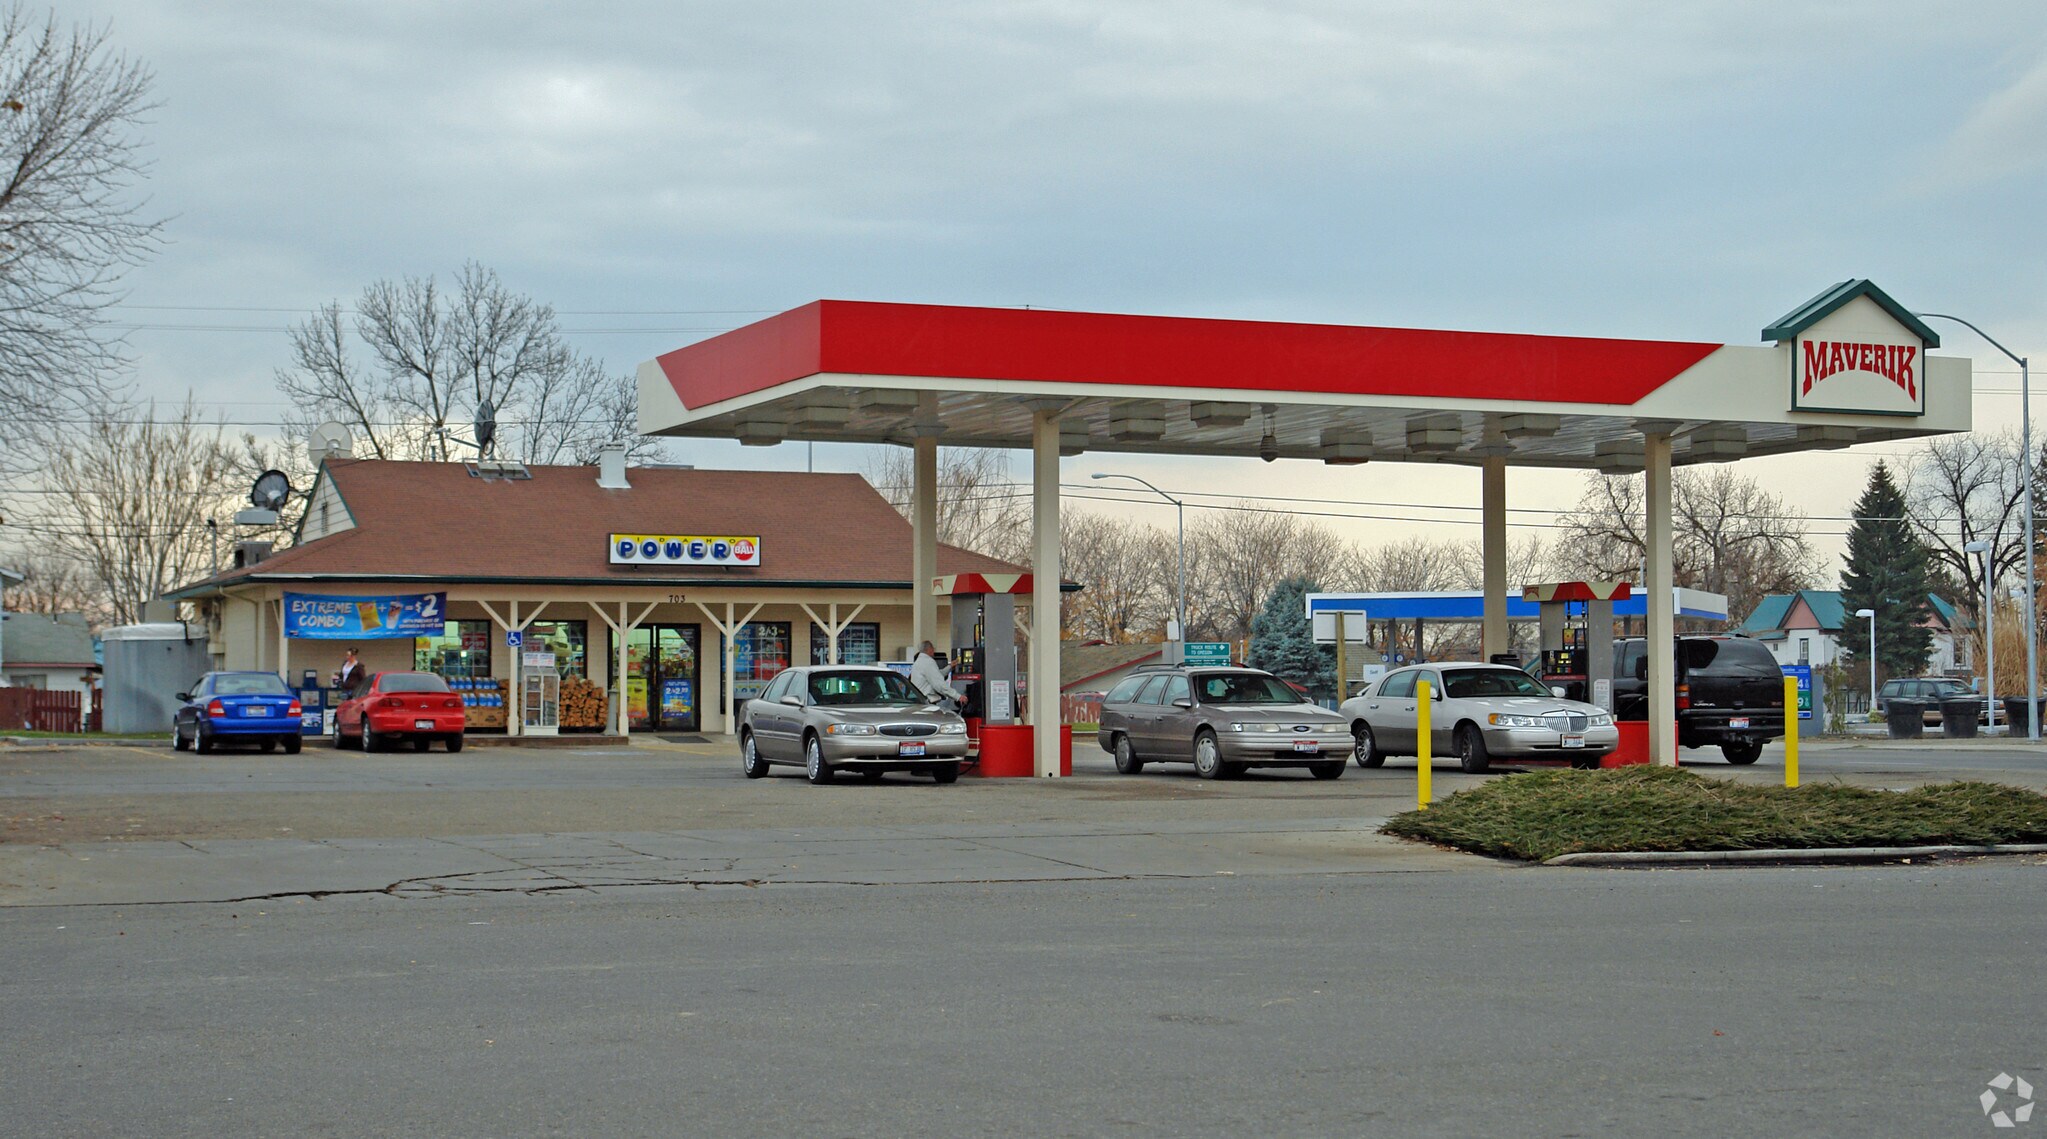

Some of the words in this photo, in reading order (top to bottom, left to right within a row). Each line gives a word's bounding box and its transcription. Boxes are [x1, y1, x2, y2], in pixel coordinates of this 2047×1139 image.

[1803, 340, 1916, 403] MAVERIK
[619, 541, 728, 559] POWER
[734, 545, 755, 555] BALL
[292, 600, 353, 614] EXTREME
[415, 594, 439, 618] $2
[668, 595, 686, 604] 703
[299, 615, 345, 628] COMBO
